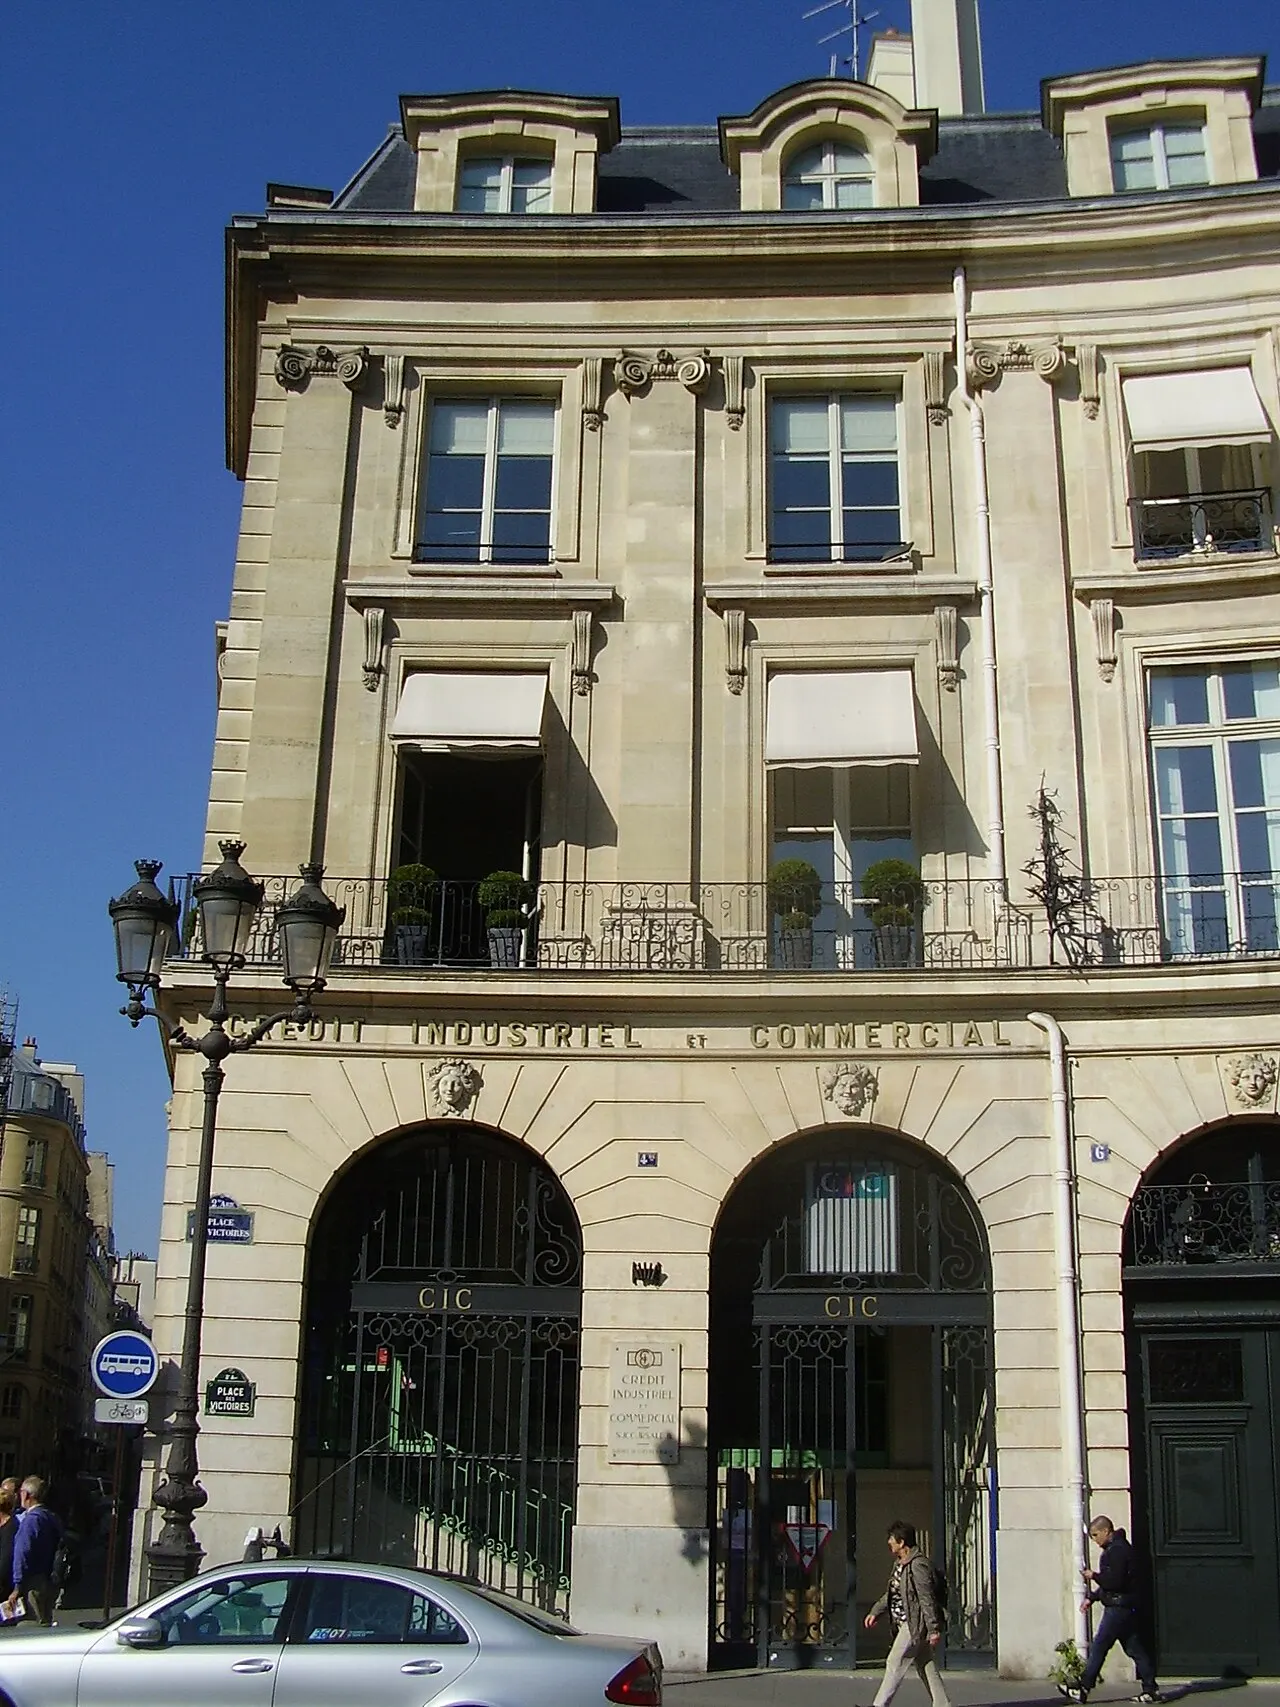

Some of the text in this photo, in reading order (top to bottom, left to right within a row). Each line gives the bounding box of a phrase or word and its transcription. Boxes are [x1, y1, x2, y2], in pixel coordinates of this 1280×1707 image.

[411, 1018, 643, 1049] INDUSTRIEL
[686, 1034, 708, 1049] ET
[750, 1019, 1011, 1049] COMMERCIAL
[1095, 1145, 1104, 1160] 6
[820, 1172, 880, 1193] CC
[207, 1218, 235, 1226] PLACE
[207, 1228, 250, 1238] VICTOIRES
[418, 1288, 473, 1310] CIC
[824, 1296, 878, 1317] CIC
[621, 1374, 665, 1386] CREDIT
[217, 1387, 245, 1397] PLACE
[210, 1401, 250, 1412] VICTOIRES
